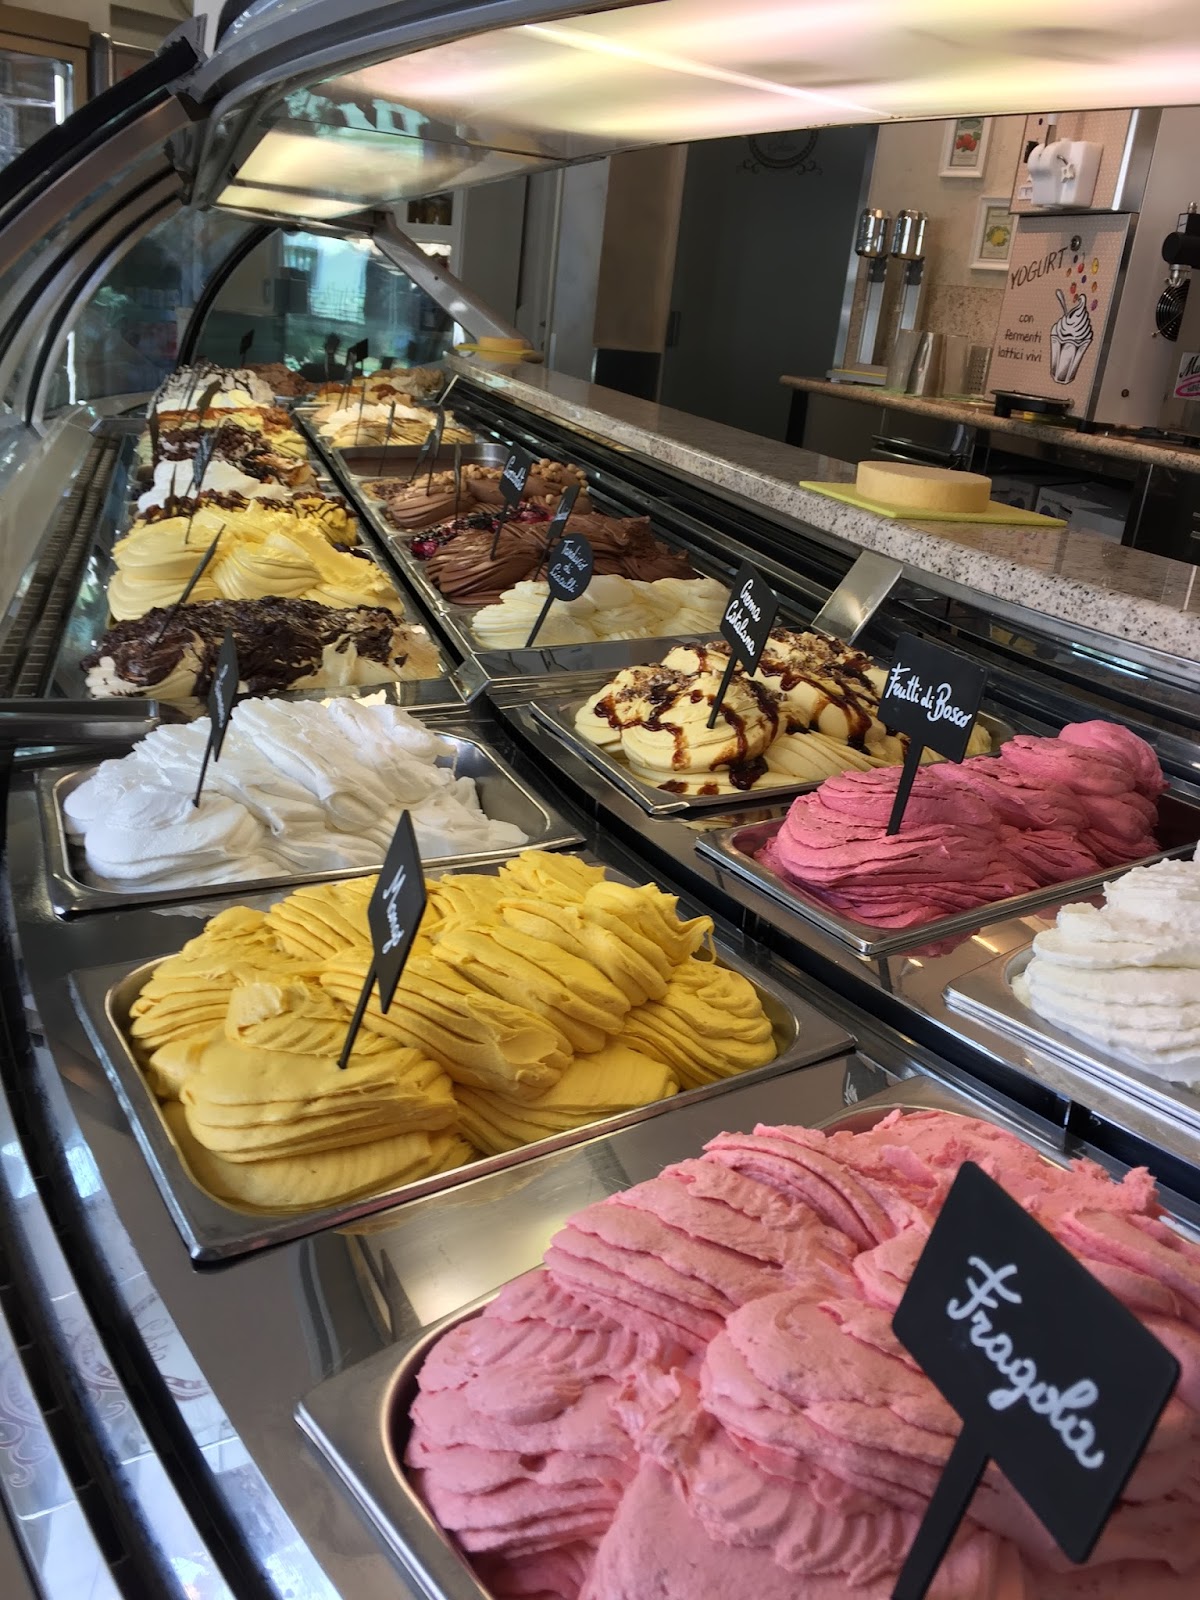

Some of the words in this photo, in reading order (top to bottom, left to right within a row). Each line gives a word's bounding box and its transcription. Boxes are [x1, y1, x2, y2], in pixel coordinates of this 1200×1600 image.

[1010, 246, 1069, 290] YOGURT
[1004, 328, 1042, 344] fermenti
[1018, 314, 1035, 324] con
[997, 345, 1024, 360] lattici
[1026, 349, 1042, 362] vivi
[739, 578, 763, 623] Crema
[724, 599, 756, 657] Catalana
[884, 662, 922, 704] Frutti
[920, 685, 935, 710] di
[926, 682, 973, 728] Bosco
[946, 1255, 1105, 1470] Fragola
